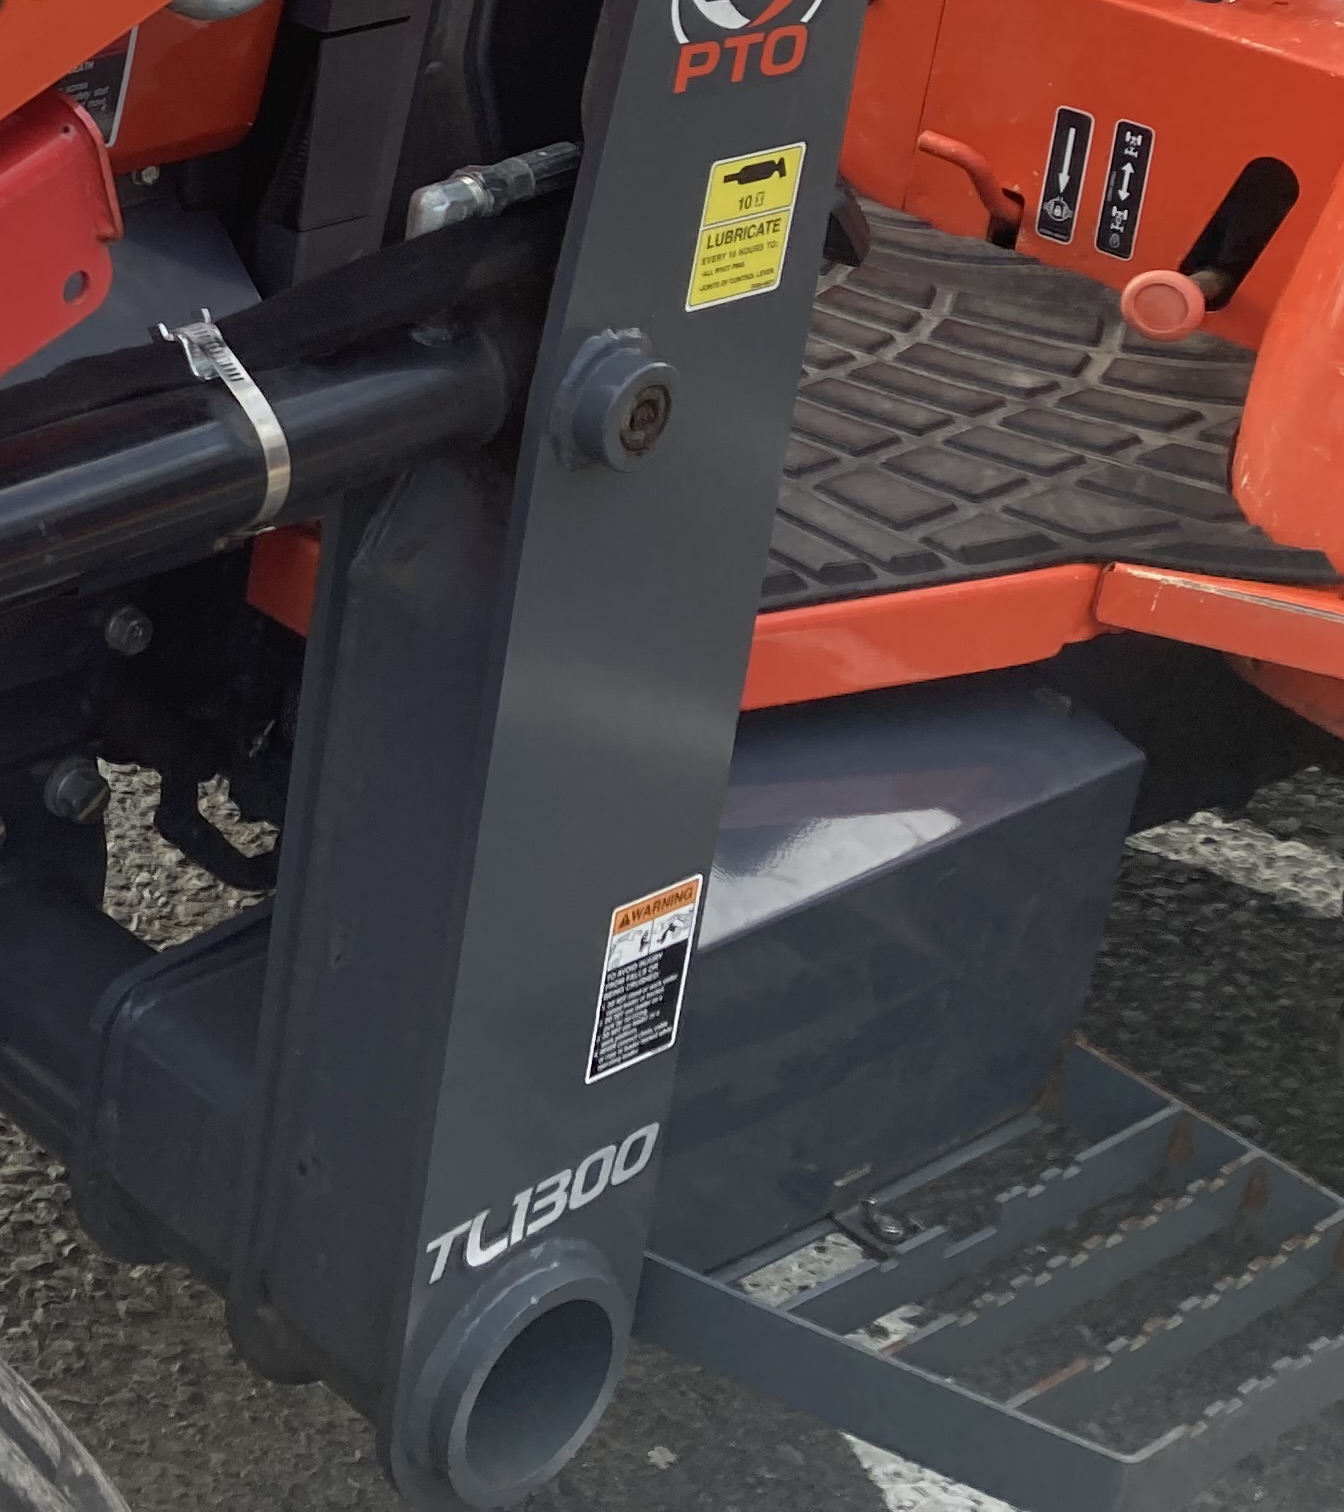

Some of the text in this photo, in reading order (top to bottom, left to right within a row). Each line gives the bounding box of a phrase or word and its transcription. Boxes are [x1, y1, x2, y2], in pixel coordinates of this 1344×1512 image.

[673, 23, 807, 95] PTO
[738, 195, 752, 211] 10
[706, 218, 781, 249] LUBRICATE
[702, 252, 726, 266] EVERY
[632, 887, 693, 923] WARNING
[426, 1122, 660, 1285] TL1300
